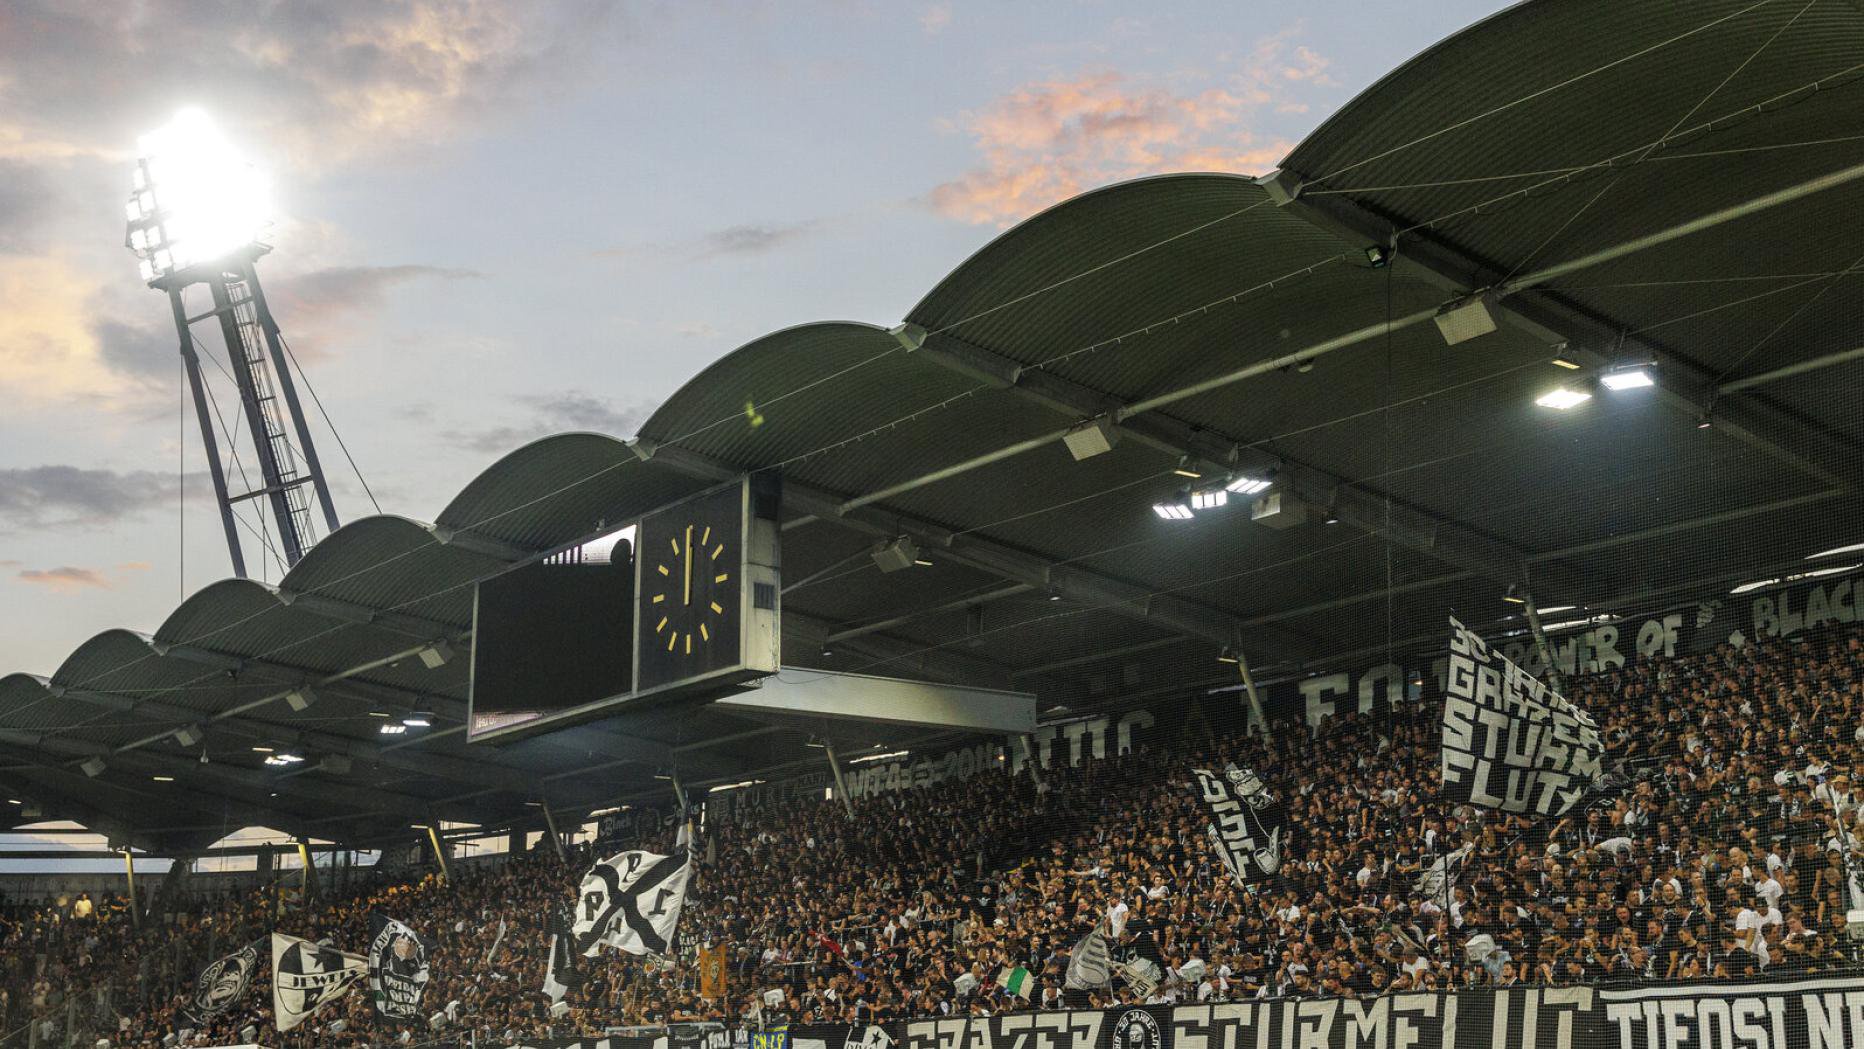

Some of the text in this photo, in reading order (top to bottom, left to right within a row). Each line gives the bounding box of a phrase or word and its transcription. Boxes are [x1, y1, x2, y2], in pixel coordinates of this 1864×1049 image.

[1636, 614, 1682, 658] OF
[1442, 696, 1603, 782] STURM
[1441, 748, 1571, 815] FLUT
